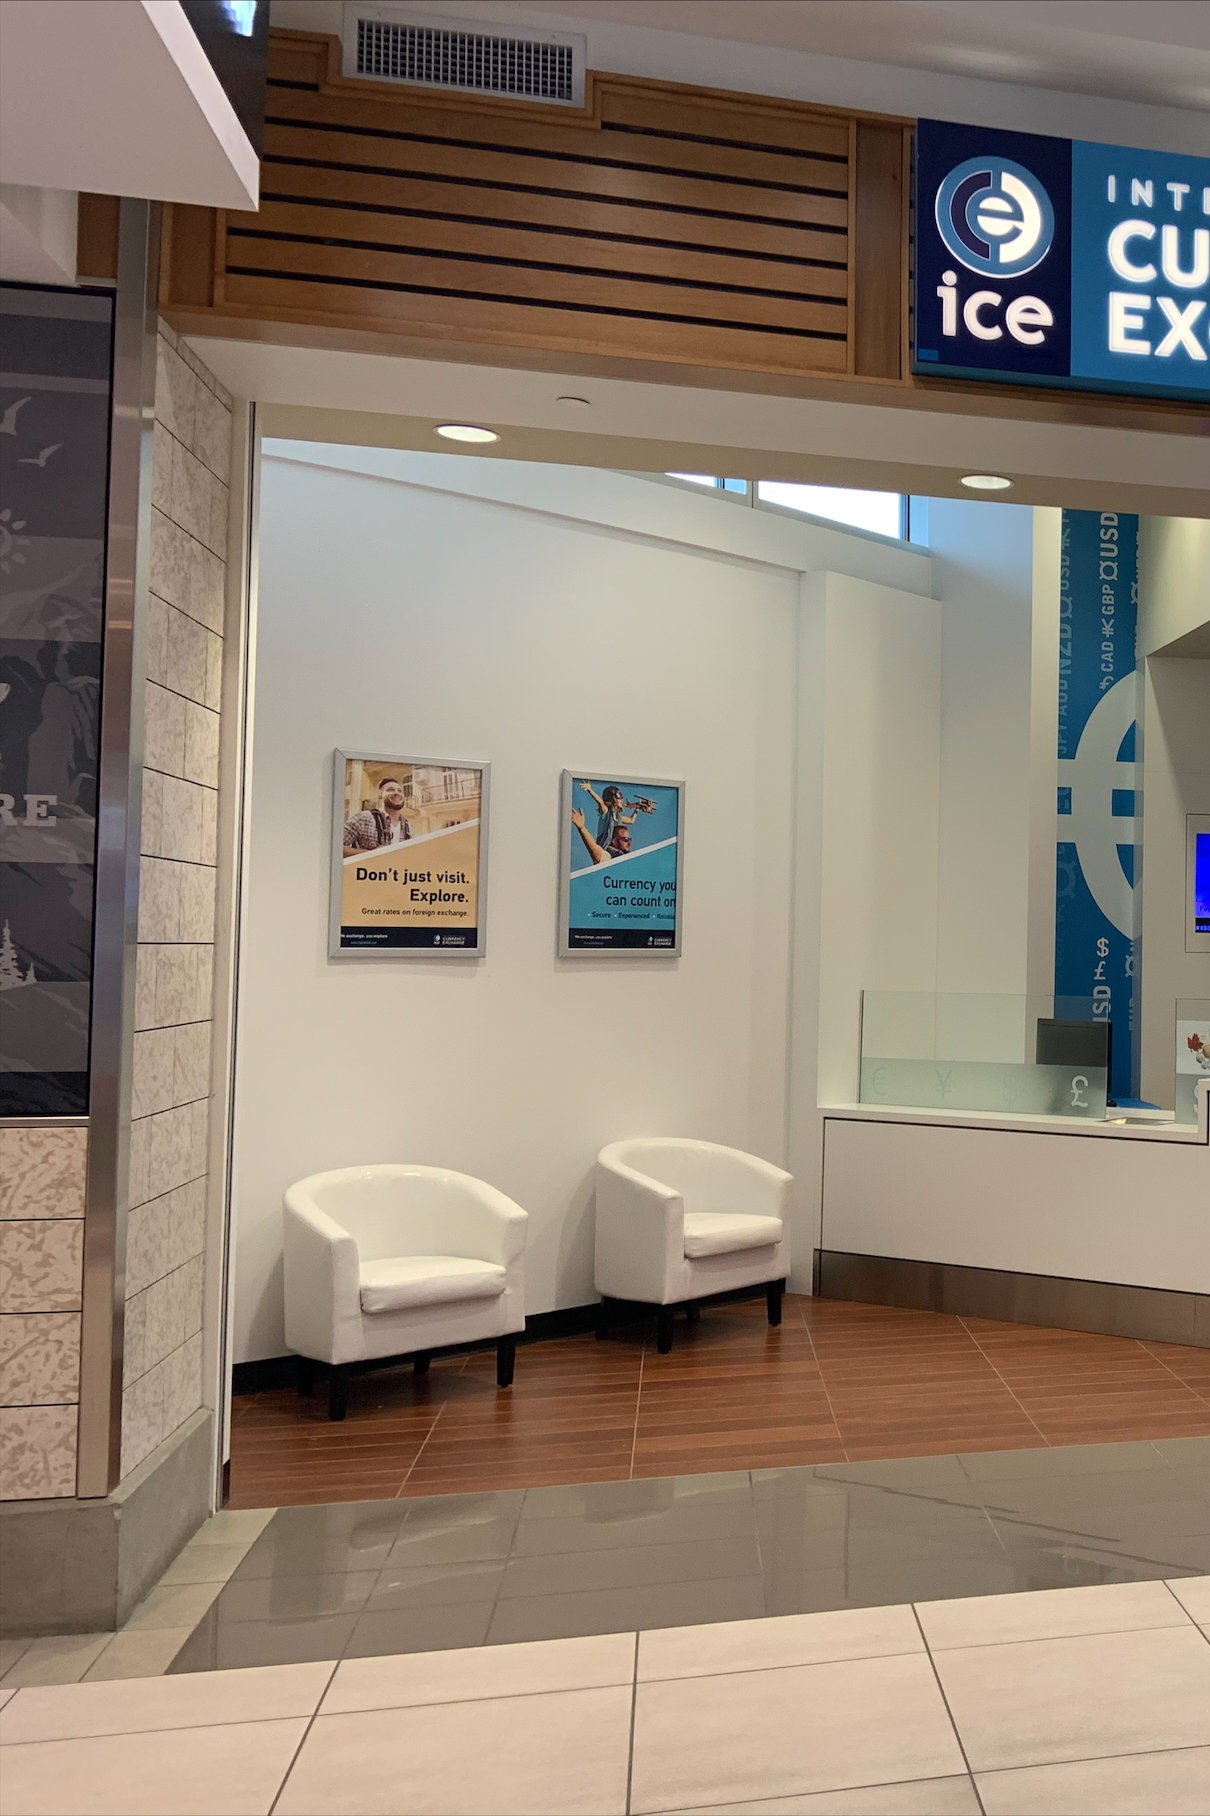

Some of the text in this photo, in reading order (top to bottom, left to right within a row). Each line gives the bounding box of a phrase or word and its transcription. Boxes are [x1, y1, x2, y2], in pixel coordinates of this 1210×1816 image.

[936, 270, 1054, 345] ice
[1100, 512, 1119, 672] CAD GBP USD
[356, 867, 470, 885] Don't just visit.
[603, 876, 676, 894] Currency you
[410, 888, 469, 905] Explore.
[606, 895, 676, 908] can count on
[361, 907, 381, 915] Great
[412, 908, 436, 917] foreign
[437, 909, 469, 918] exchange.
[592, 911, 611, 919] Secure
[618, 912, 650, 920] Experienced
